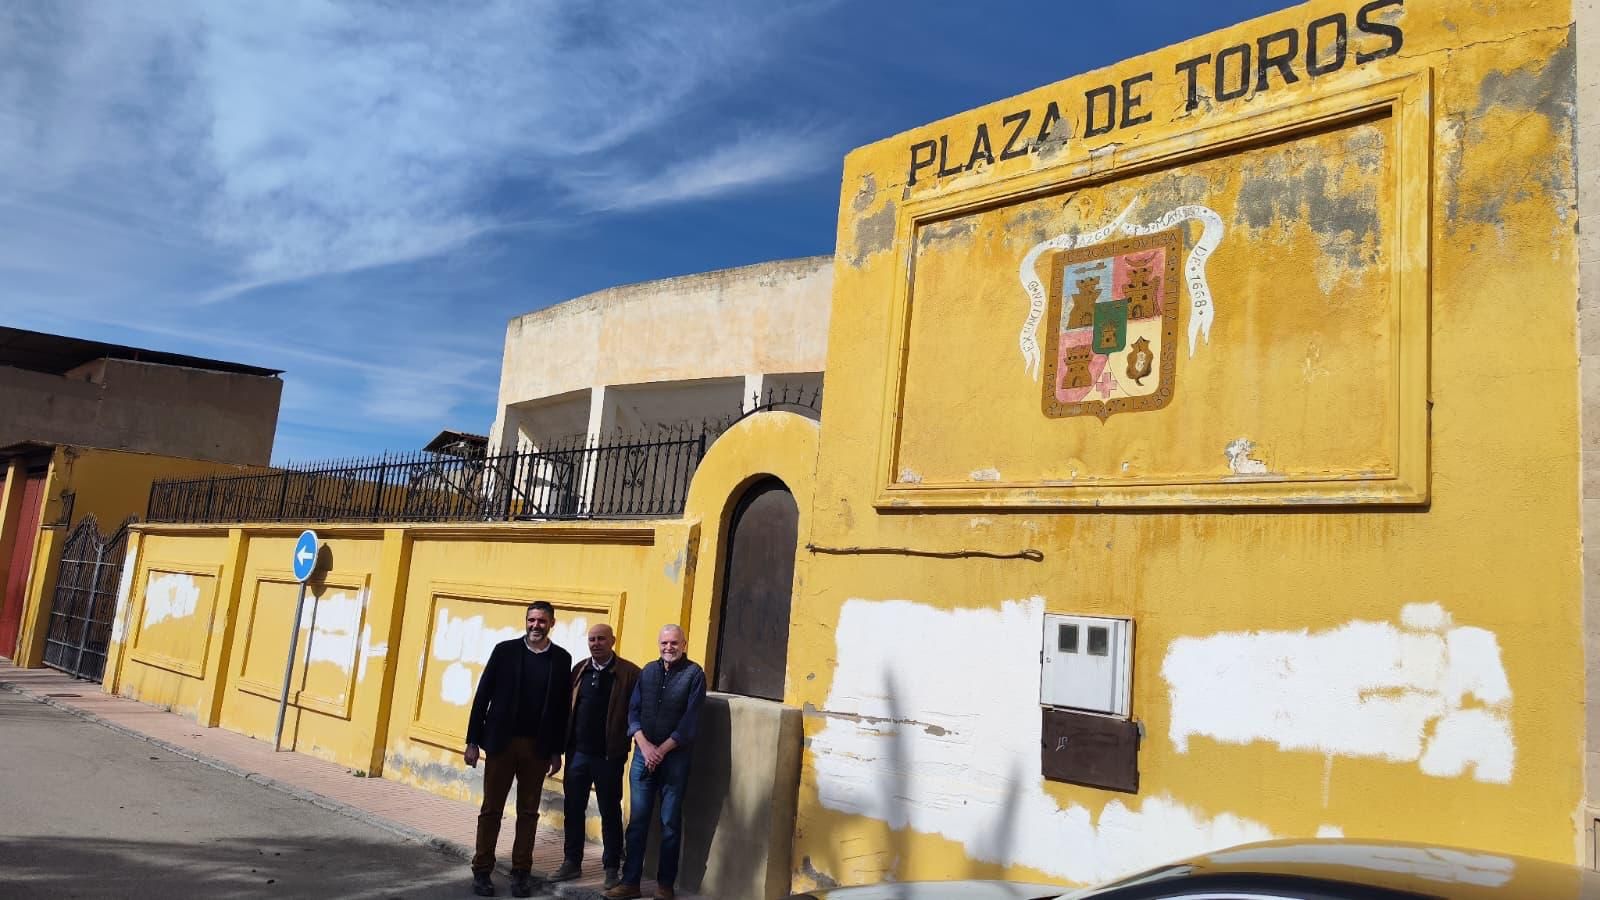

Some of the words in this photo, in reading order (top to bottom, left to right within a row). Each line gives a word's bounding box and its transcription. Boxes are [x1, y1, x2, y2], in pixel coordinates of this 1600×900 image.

[908, 101, 1070, 187] PLAZA
[1083, 71, 1153, 139] DE
[1175, 0, 1404, 113] TOROS
[1192, 273, 1208, 309] 1668
